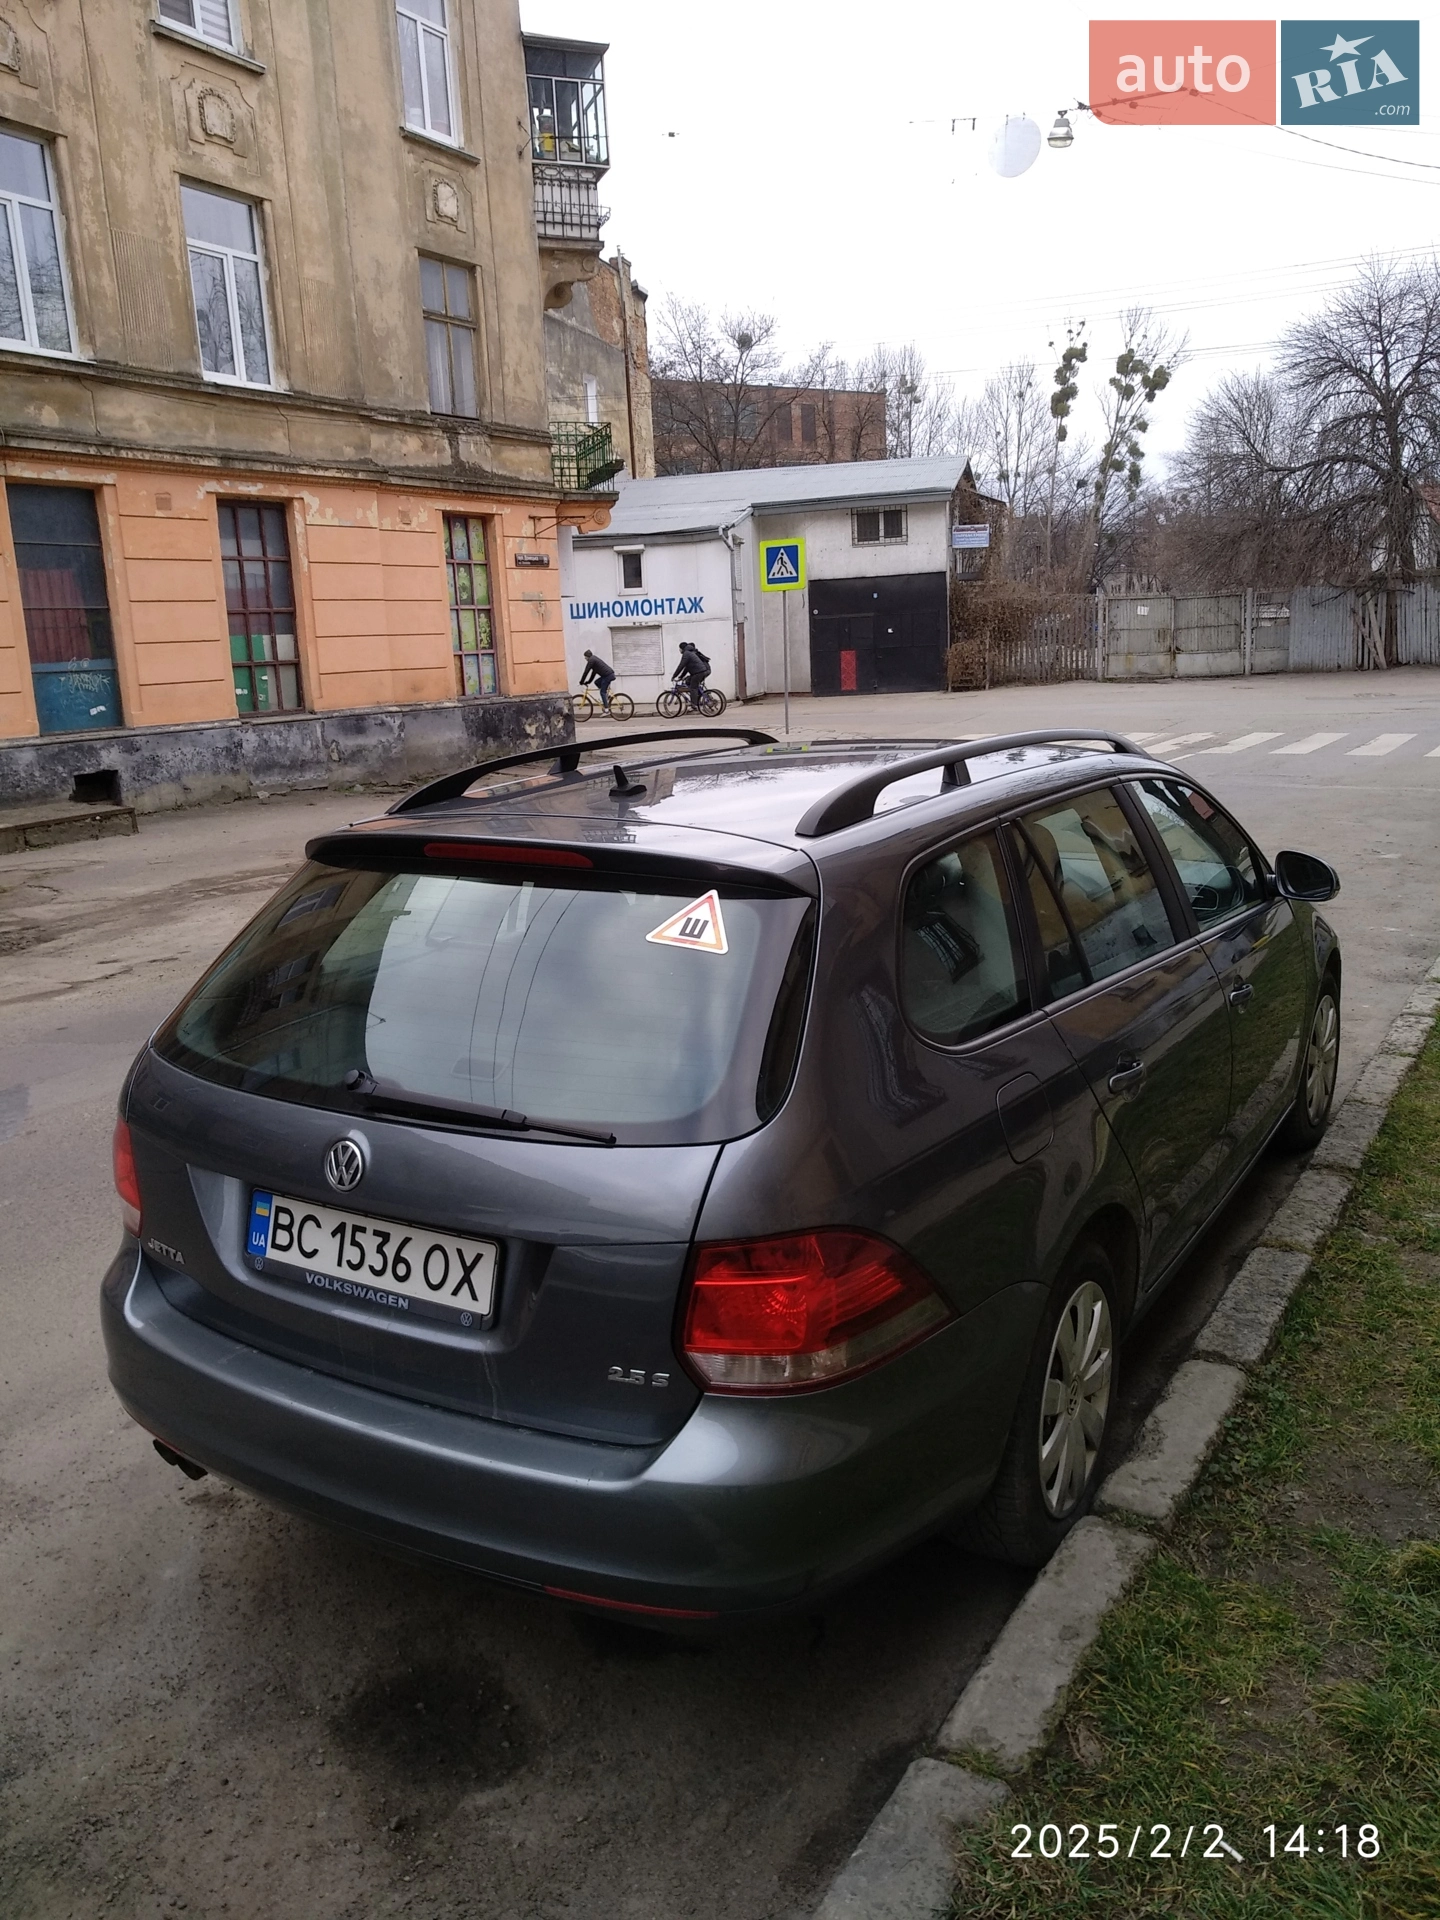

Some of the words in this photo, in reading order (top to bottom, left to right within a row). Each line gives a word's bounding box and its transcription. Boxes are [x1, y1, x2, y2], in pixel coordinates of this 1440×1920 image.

[569, 596, 705, 620] ШИНОМОНТАЖ
[148, 1237, 185, 1265] JETTA
[252, 1231, 266, 1248] UA
[330, 1221, 413, 1283] 1536
[305, 1272, 410, 1310] VOLKSWAGEN
[651, 1372, 670, 1388] S
